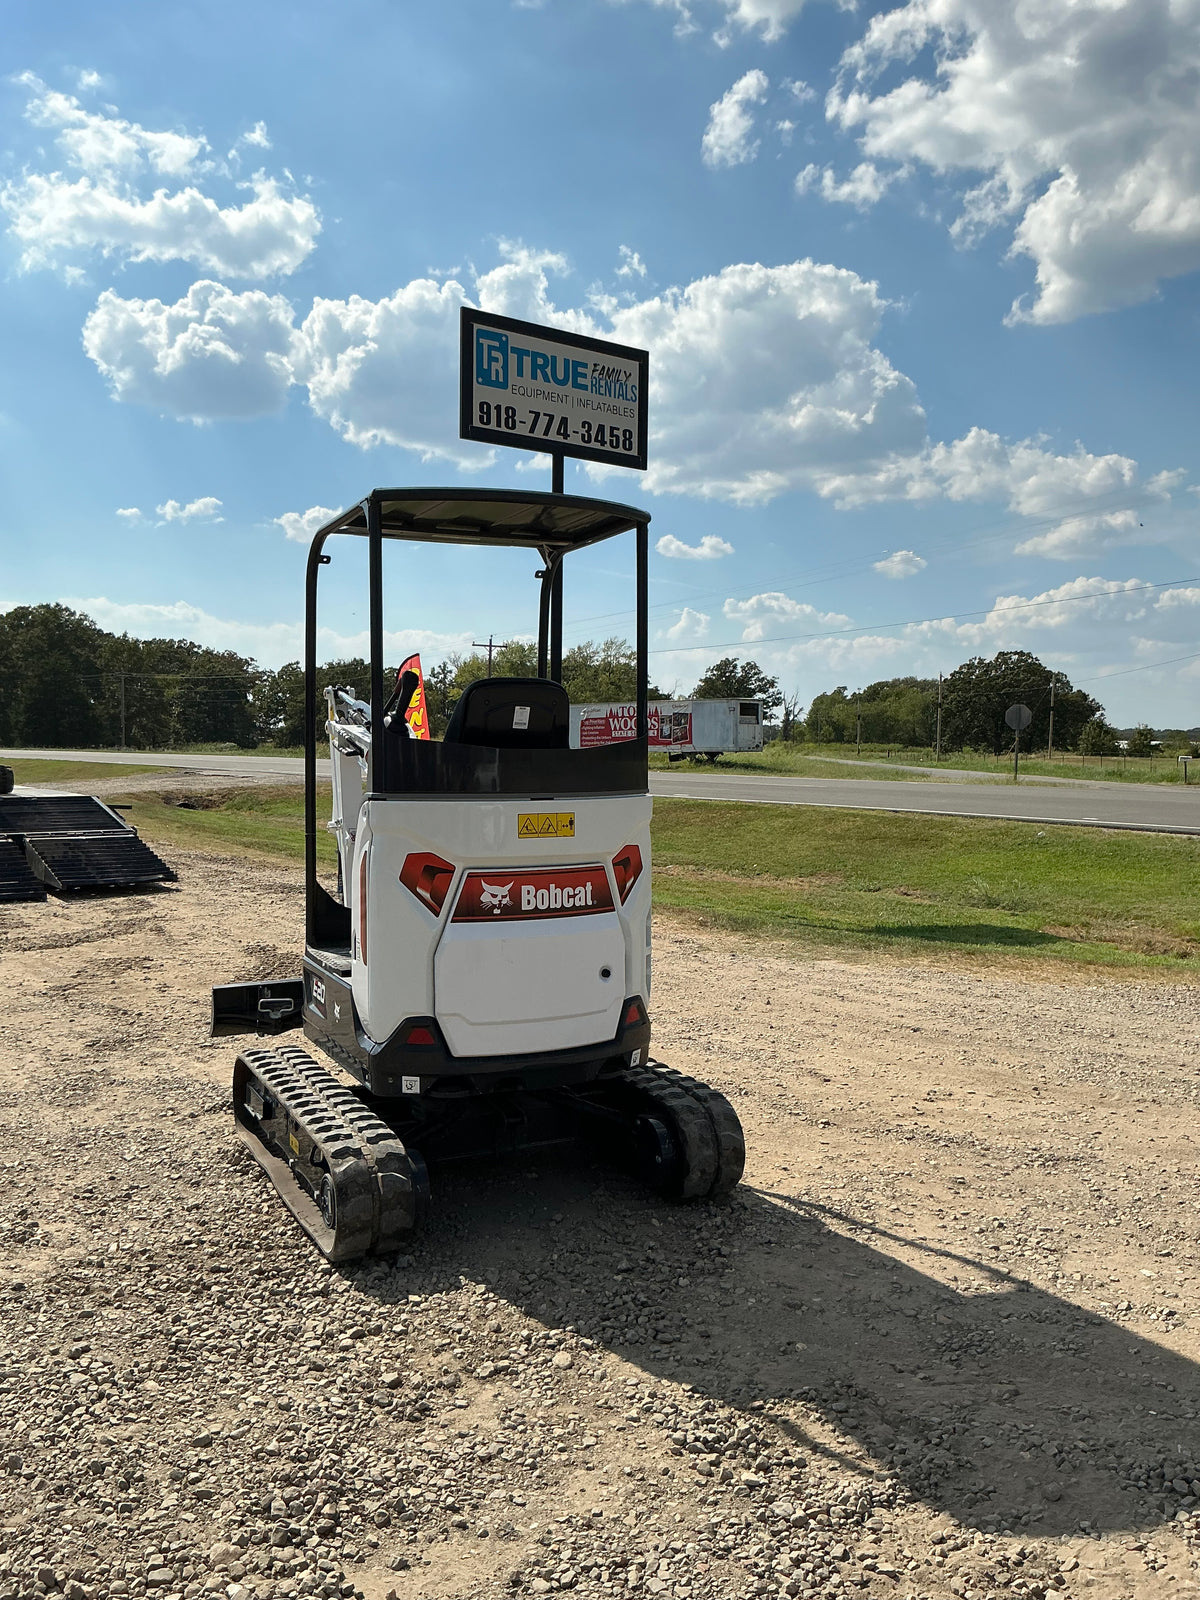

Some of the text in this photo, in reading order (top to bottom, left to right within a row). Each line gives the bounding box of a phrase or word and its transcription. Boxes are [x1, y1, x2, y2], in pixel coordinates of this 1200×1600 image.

[510, 346, 588, 391] TRUE
[591, 363, 632, 385] FAMILY
[511, 384, 635, 419] EQUIPMENT INFLATABLES
[591, 376, 637, 403] RENTALS
[478, 401, 633, 452] 918-774-3458
[408, 667, 425, 739] ENT
[521, 882, 593, 911] Bobcat
